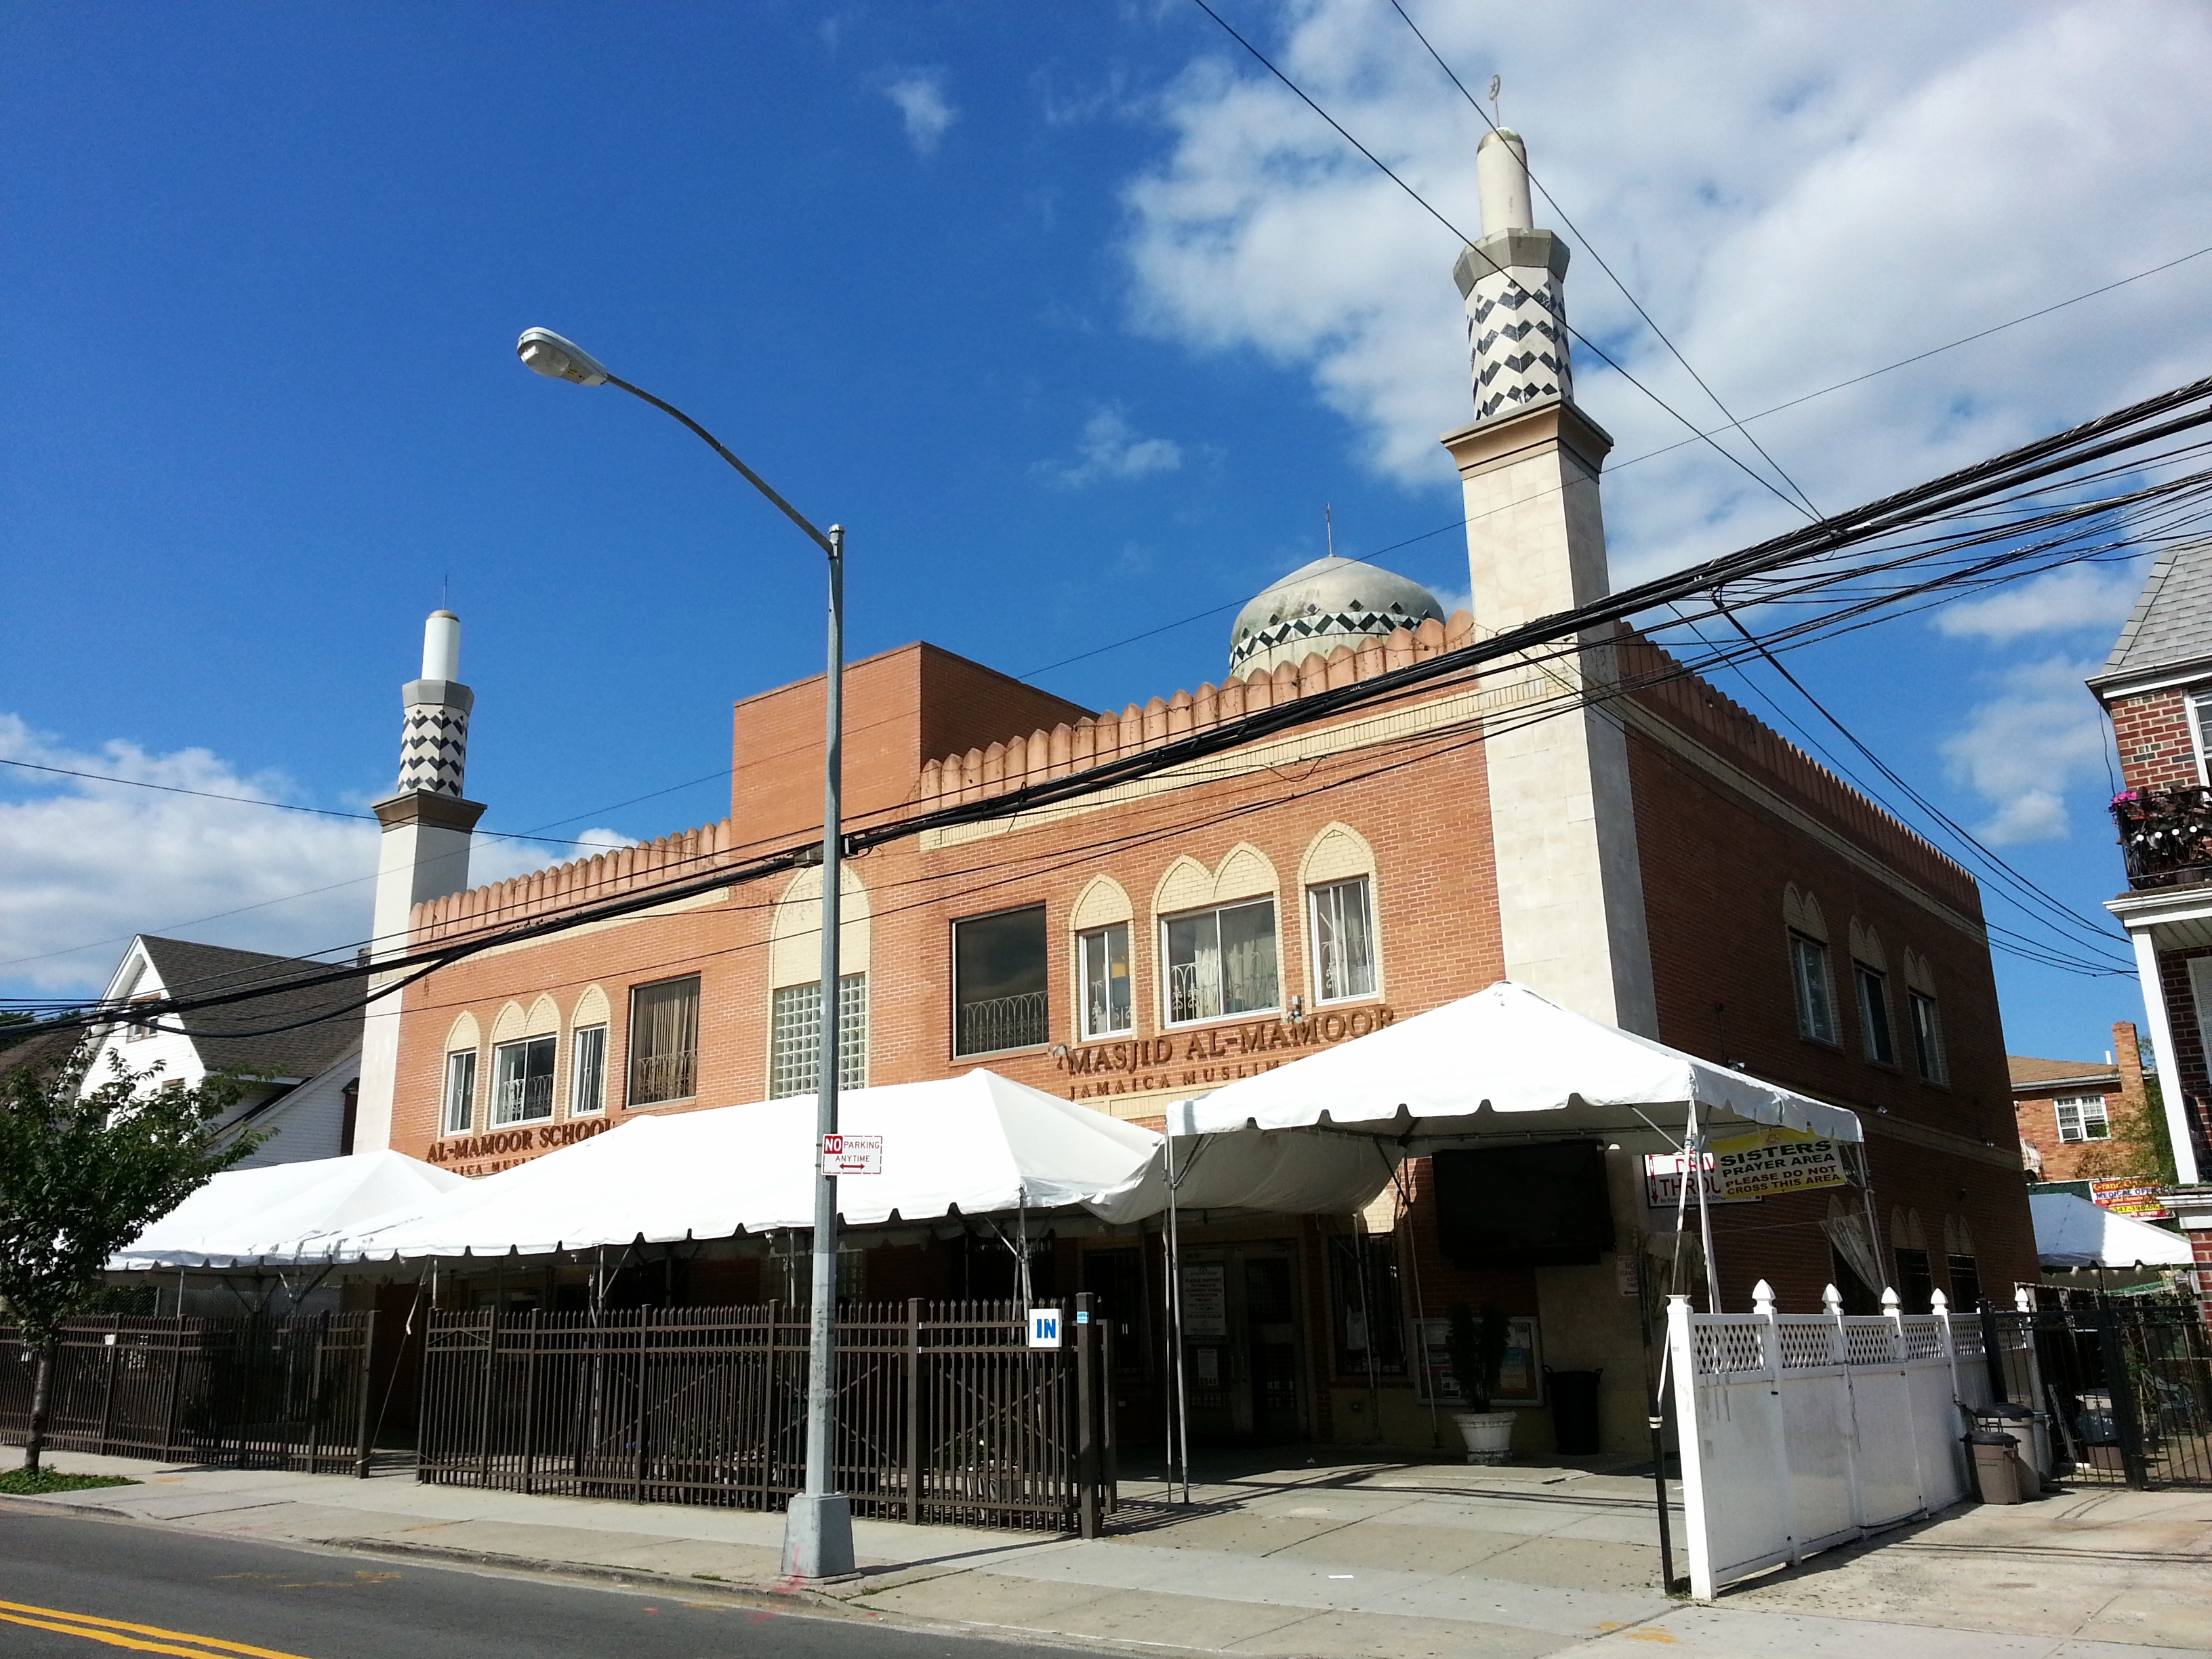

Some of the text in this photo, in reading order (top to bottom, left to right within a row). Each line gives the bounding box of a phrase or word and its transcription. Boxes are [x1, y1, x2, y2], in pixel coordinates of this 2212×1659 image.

[1067, 1006, 1395, 1076] MASJID AL-MAMOOR
[1069, 1059, 1280, 1101] JAMAICA MUSLIM
[426, 1118, 615, 1163] AL-MAMOOR SCHOOL
[825, 1138, 842, 1151] NO
[1721, 1140, 1832, 1166] SISTERS
[1722, 1153, 1835, 1177] PRAYER AREA
[1725, 1165, 1837, 1187] PLEASE DO NOT
[1727, 1174, 1841, 1195] CROSS THIS AREA
[2096, 1189, 2133, 1200] MEDICAL
[1036, 1318, 1057, 1338] IN
